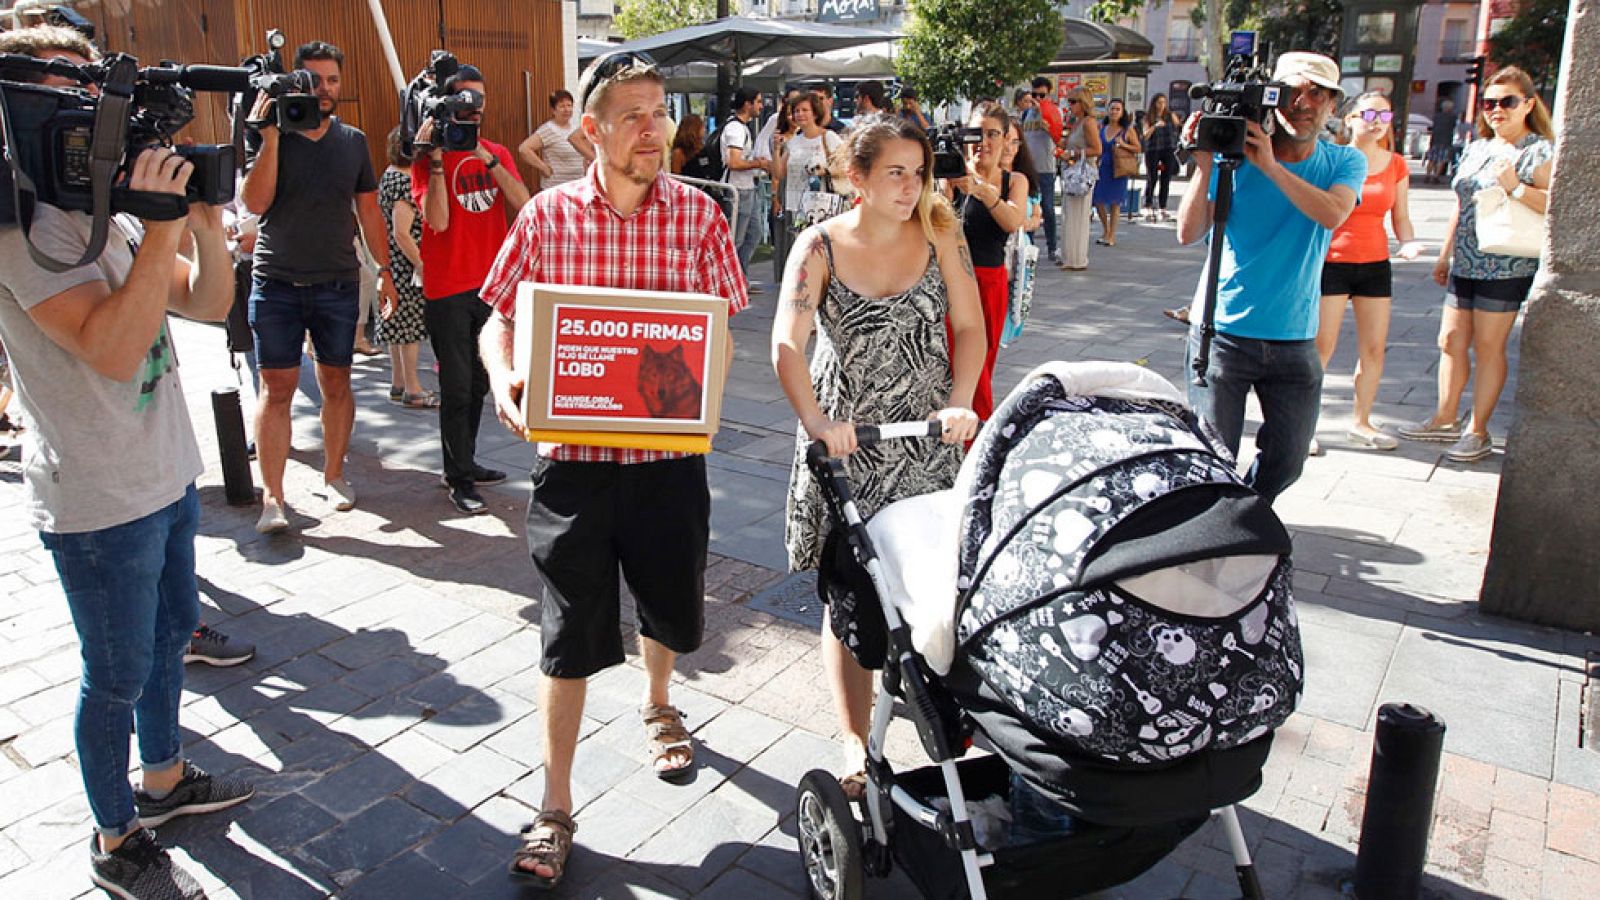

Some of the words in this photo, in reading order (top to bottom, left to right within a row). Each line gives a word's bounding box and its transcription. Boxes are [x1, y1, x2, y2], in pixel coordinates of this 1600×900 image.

[560, 319, 628, 336] 25.000
[632, 323, 704, 341] FIRMAS
[582, 345, 599, 353] QUE
[600, 346, 639, 355] NUESTRO
[577, 352, 588, 360] SE
[589, 353, 615, 361] LLAME
[559, 361, 605, 376] LOBO
